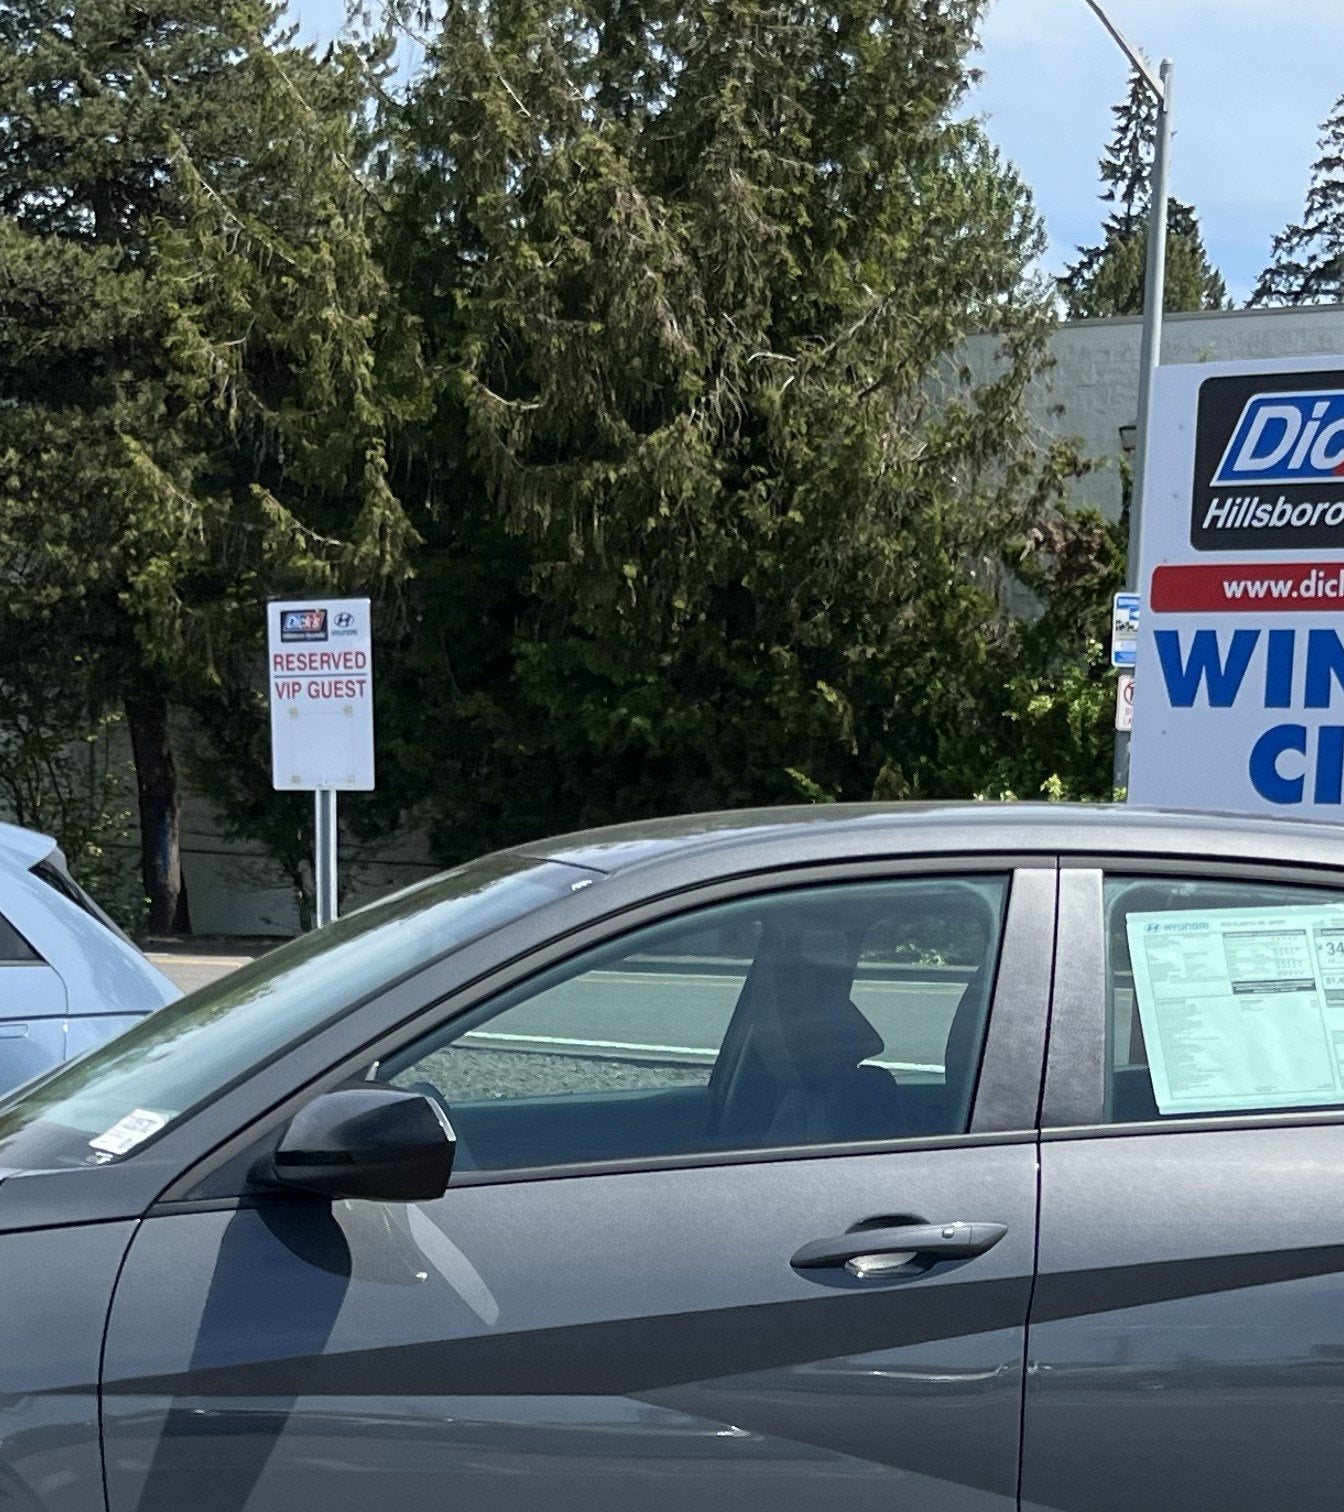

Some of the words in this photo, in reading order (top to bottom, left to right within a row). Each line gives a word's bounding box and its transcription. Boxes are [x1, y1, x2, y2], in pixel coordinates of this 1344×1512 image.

[273, 651, 367, 672] RESERVED
[274, 681, 302, 700] VIP
[308, 680, 367, 700] GUEST
